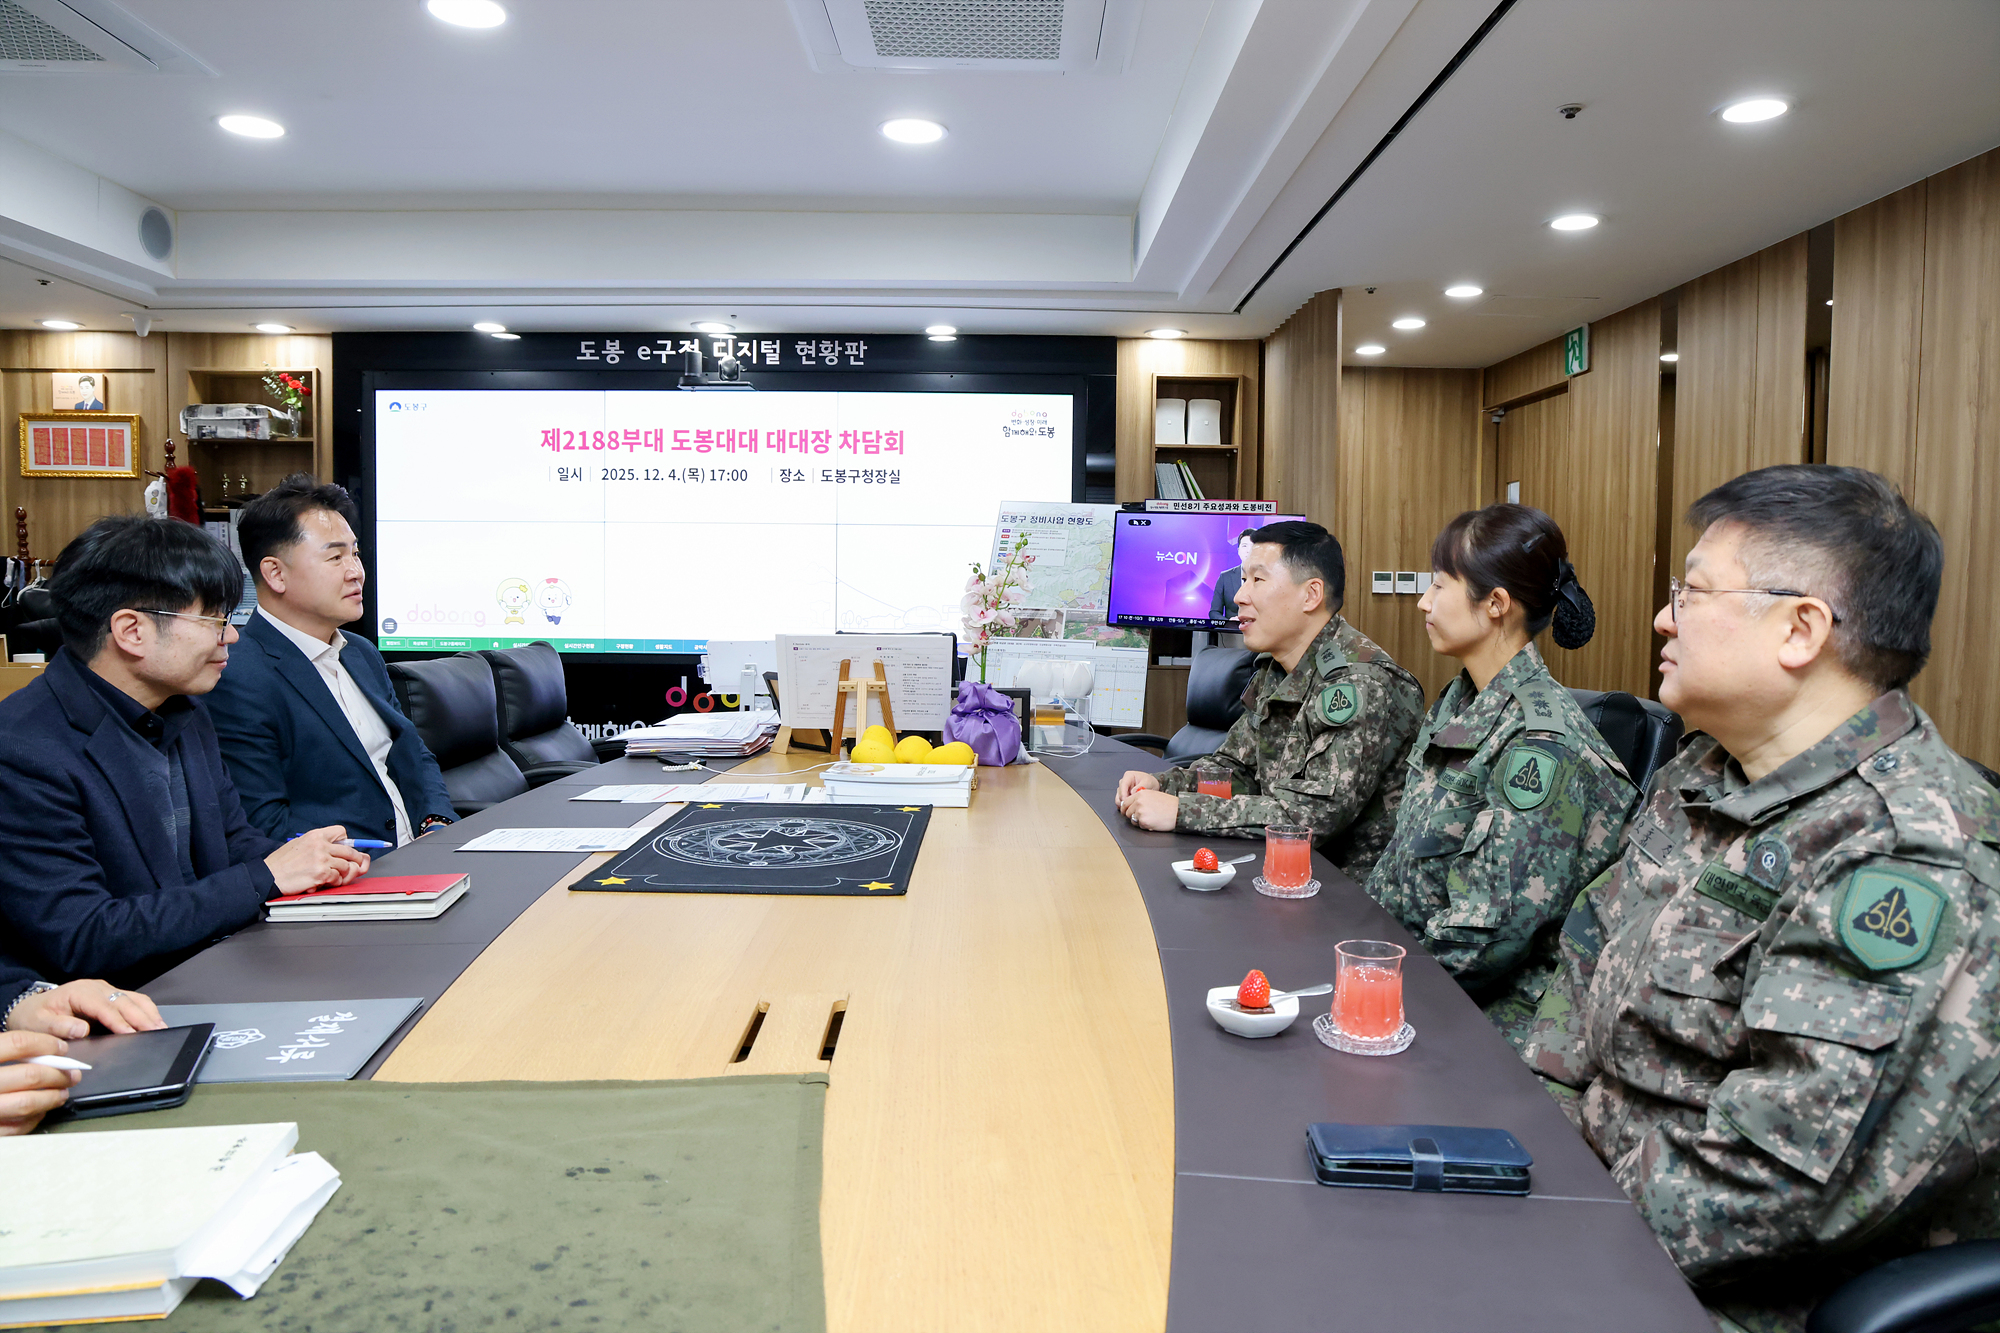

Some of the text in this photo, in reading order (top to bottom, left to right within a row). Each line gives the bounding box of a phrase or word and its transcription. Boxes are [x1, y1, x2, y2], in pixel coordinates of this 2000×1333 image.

[576, 340, 625, 365] 도봉
[713, 339, 781, 365] 디지털
[795, 340, 868, 366] 현황판
[404, 403, 427, 411] 도봉구
[541, 428, 904, 455] 제2188부대 도봉대대 대대장 차담회
[1038, 426, 1056, 439] 도봉
[557, 467, 901, 485] 일시 2025. 12. 4.(목) 17:00 장소 도봉구청장실
[1173, 502, 1200, 511] 민선8기
[1203, 502, 1240, 511] 주요성과와
[1242, 503, 1272, 512] 도봉비전
[1001, 514, 1094, 526] 도봉구 정비사업 현황도
[1155, 550, 1198, 566] 뉴스ON
[406, 603, 487, 628] dobong
[1515, 767, 1540, 789] 56
[1703, 871, 1748, 902] 대한민국
[1864, 901, 1910, 938] 56
